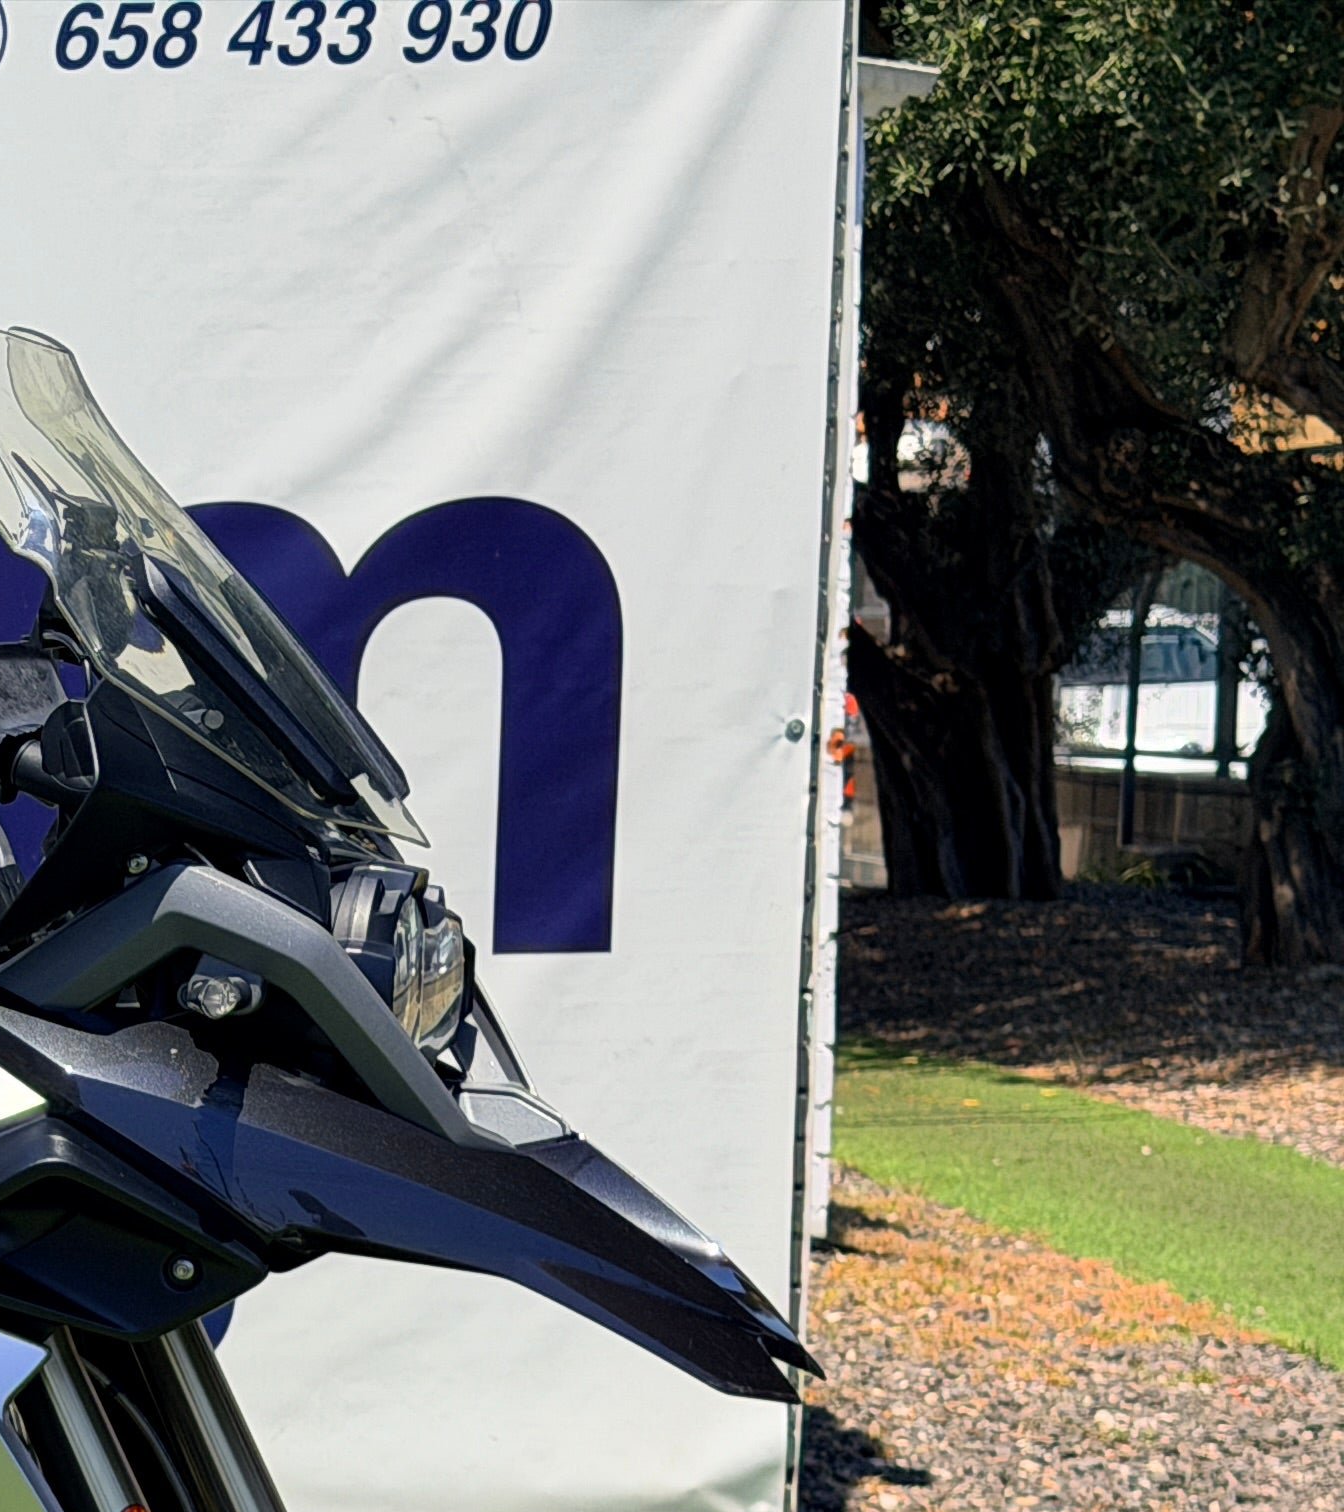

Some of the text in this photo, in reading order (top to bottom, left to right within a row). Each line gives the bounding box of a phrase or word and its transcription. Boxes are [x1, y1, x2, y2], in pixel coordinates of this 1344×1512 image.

[54, 0, 553, 71] 658 433 930
